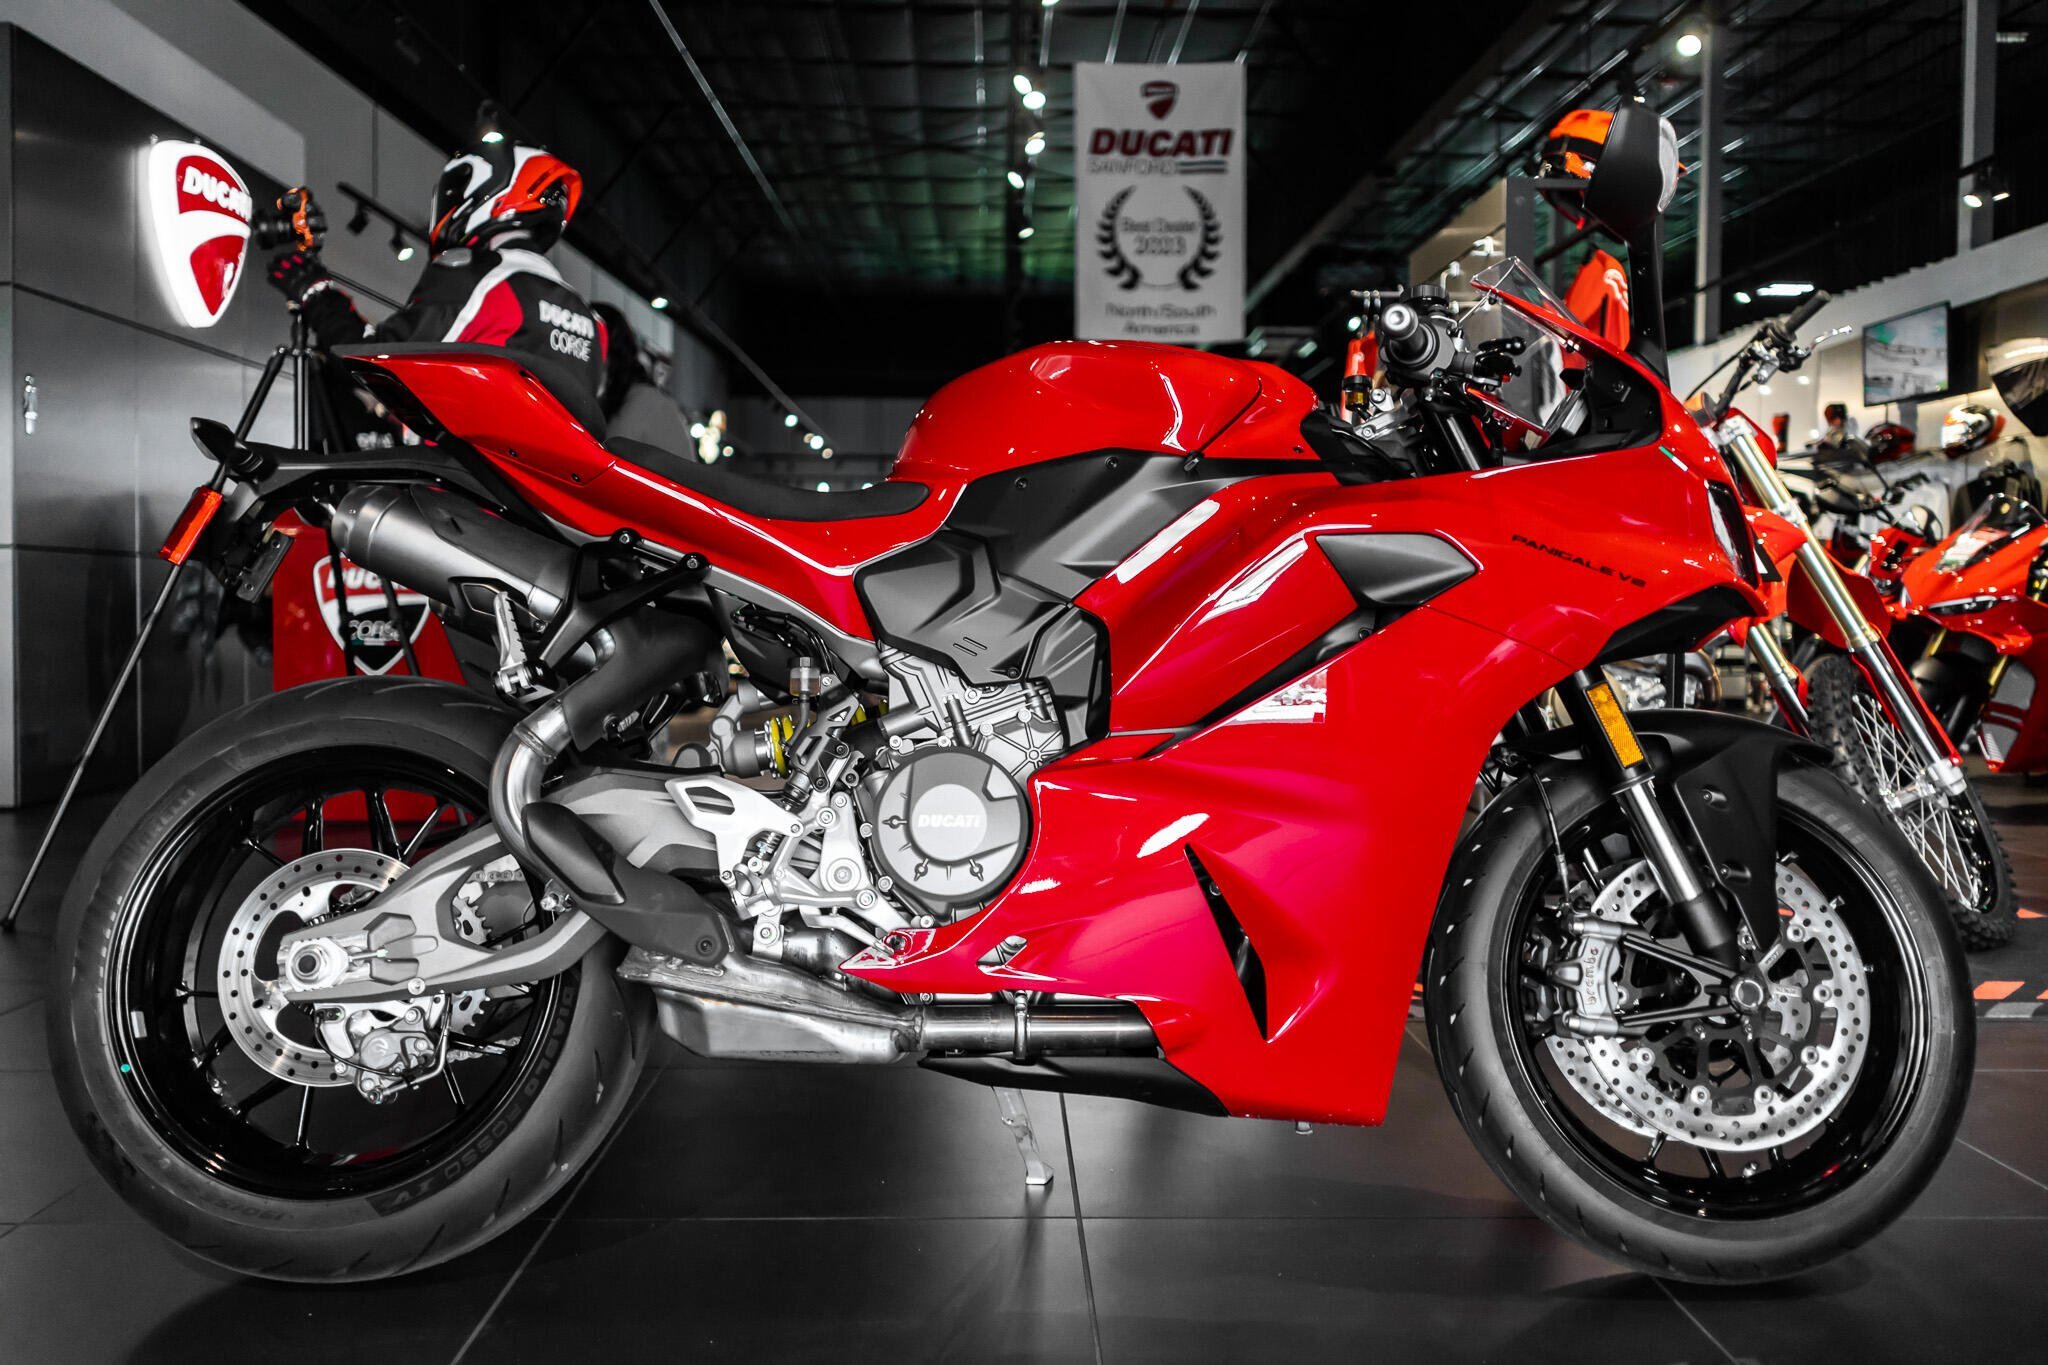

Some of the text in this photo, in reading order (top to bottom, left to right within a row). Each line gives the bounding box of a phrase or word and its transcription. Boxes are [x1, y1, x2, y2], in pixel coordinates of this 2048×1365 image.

[1089, 128, 1234, 157] DUCATI
[1134, 235, 1187, 256] 2023
[538, 299, 595, 340] DUCATI
[549, 328, 592, 362] CORSE
[1511, 534, 1616, 576] PANIGALE
[918, 814, 981, 828] DUCATI
[1583, 945, 1599, 1006] brembo
[443, 1101, 523, 1180] ROSSO
